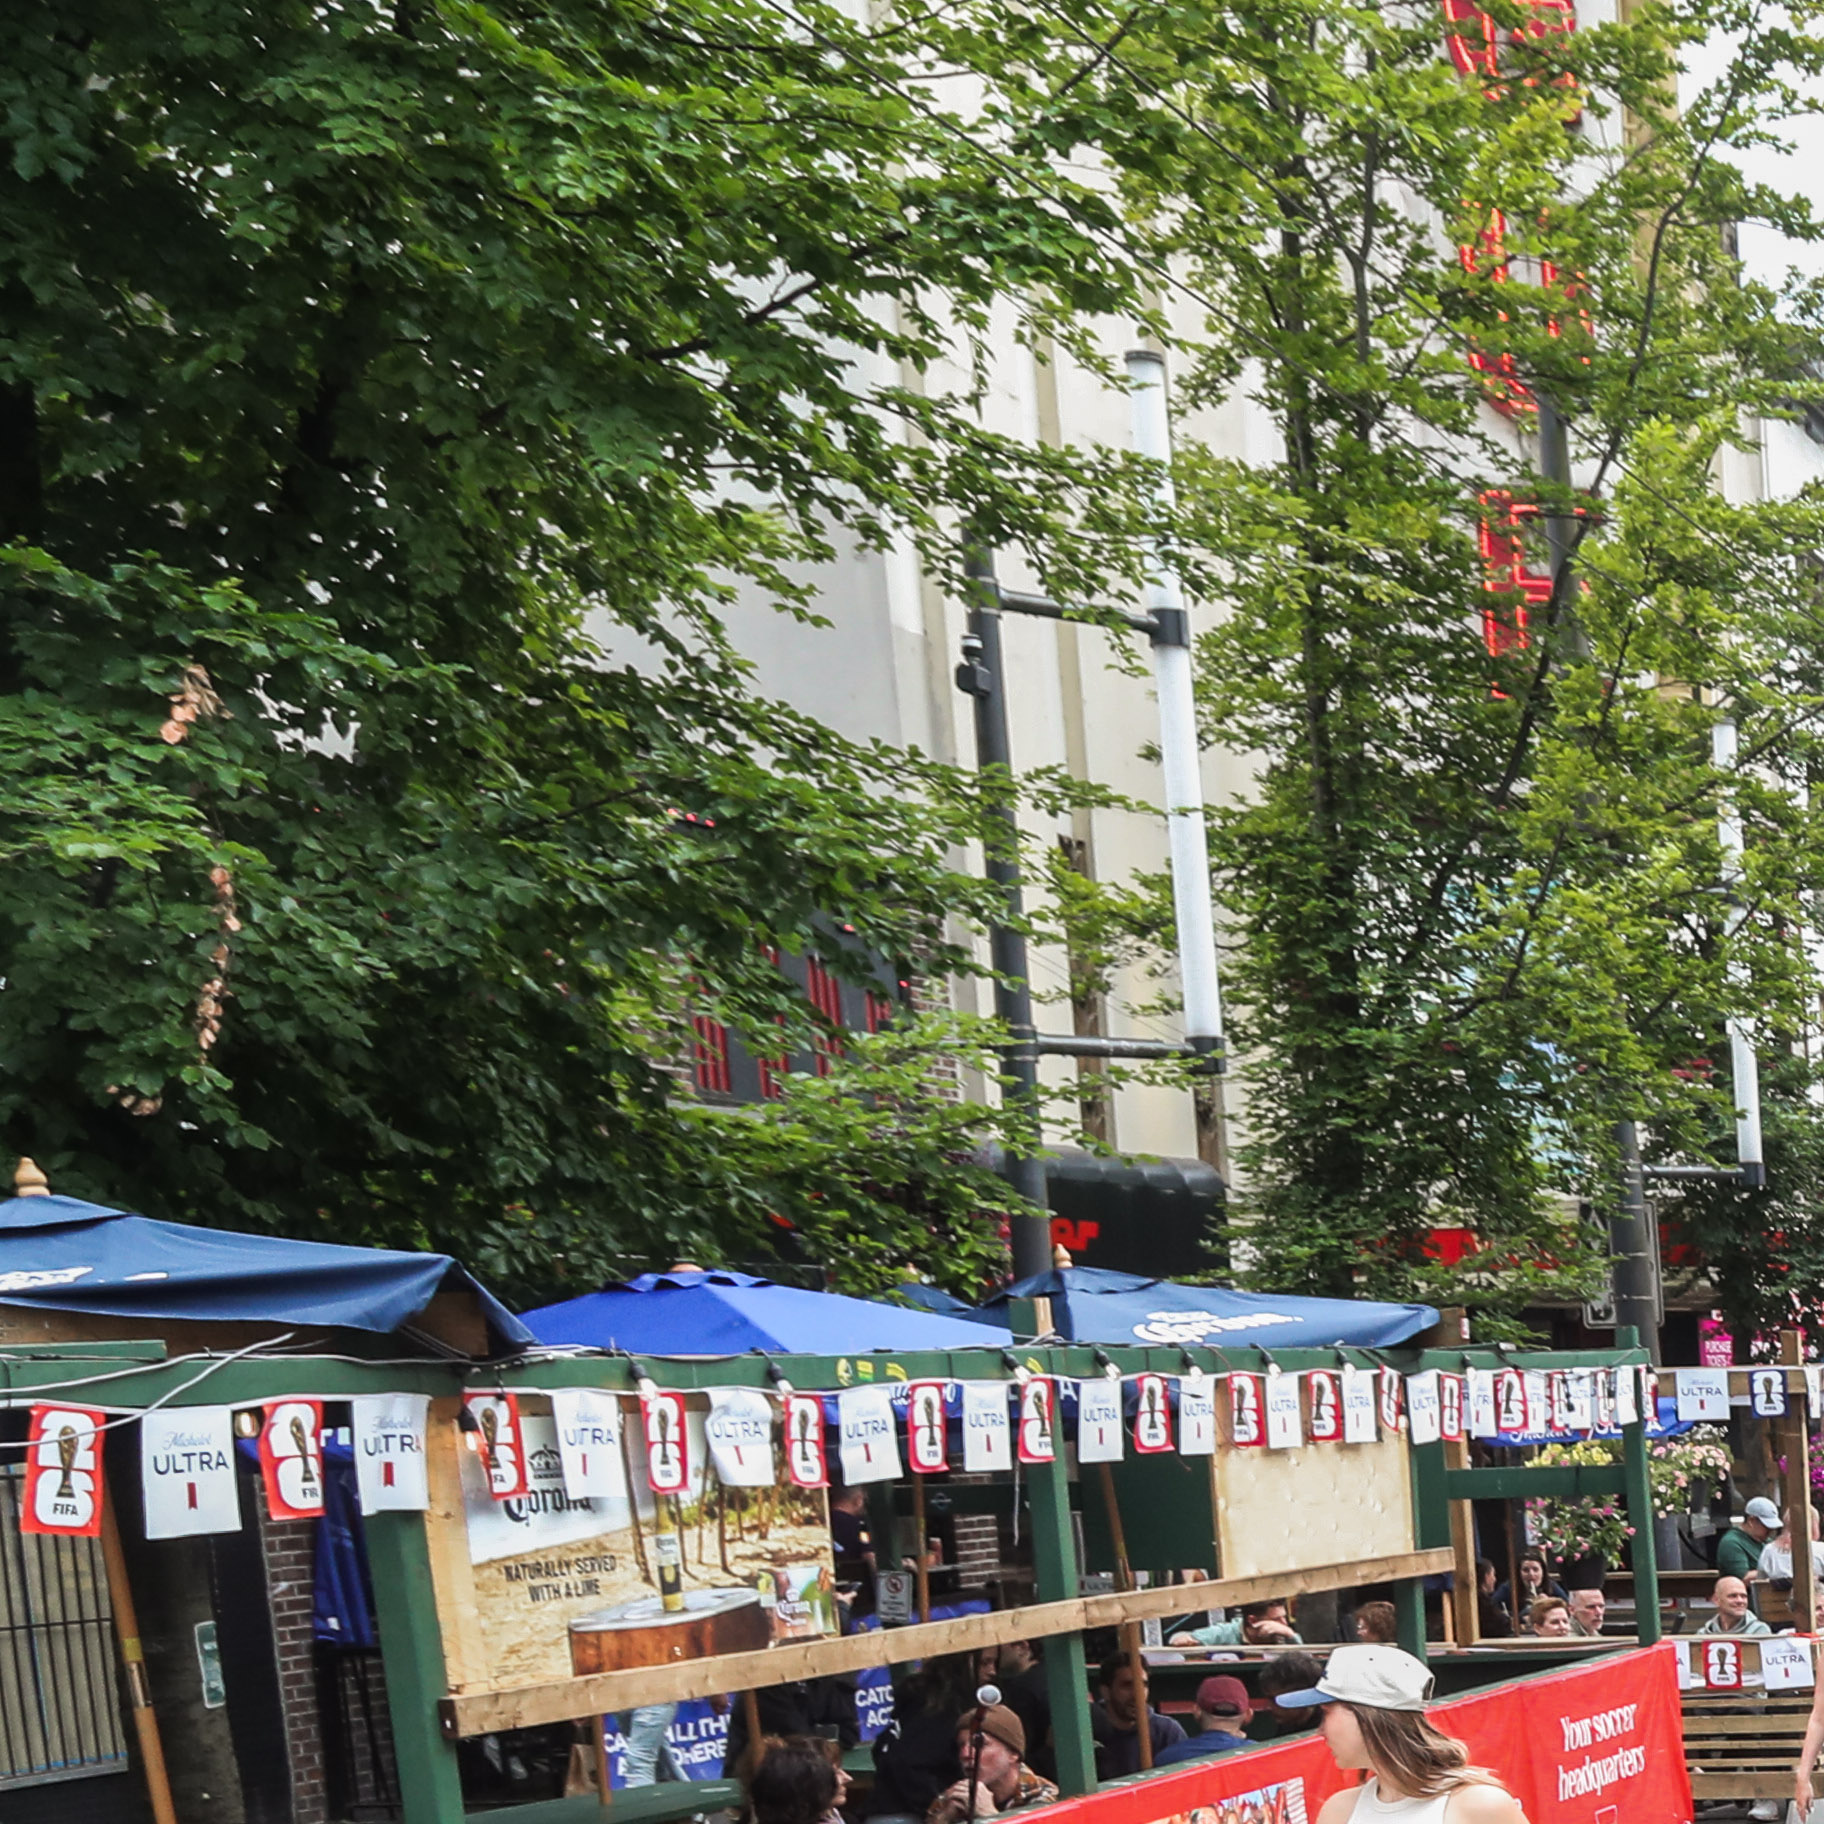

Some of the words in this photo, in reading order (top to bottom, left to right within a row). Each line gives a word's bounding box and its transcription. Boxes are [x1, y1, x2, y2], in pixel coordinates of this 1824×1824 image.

[1705, 1339, 1733, 1355] PURCHASE
[1681, 1386, 1723, 1398] ULTRA
[1184, 1403, 1214, 1417] ULTRA
[1270, 1399, 1297, 1412] ULTRA
[1346, 1397, 1373, 1409] ULTRA
[968, 1412, 1007, 1428] ULTRA
[1083, 1407, 1119, 1423] ULTRA
[564, 1427, 617, 1448] ULTRA
[711, 1419, 765, 1440] ULTRA
[845, 1420, 889, 1440] ULTRA
[363, 1433, 423, 1457] ULTRA
[152, 1450, 231, 1477] ULTRA
[52, 1501, 79, 1518] FIFA
[504, 1558, 574, 1583] NATURALLY
[574, 1554, 618, 1576] SERVED
[527, 1582, 563, 1603] WITH
[564, 1582, 574, 1598] A
[574, 1578, 602, 1598] LIME
[1765, 1653, 1807, 1667] ULTRA
[854, 1685, 895, 1707] CATC
[1559, 1715, 1593, 1753] Your
[1591, 1703, 1638, 1743] soccer
[1557, 1745, 1646, 1802] headquarters
